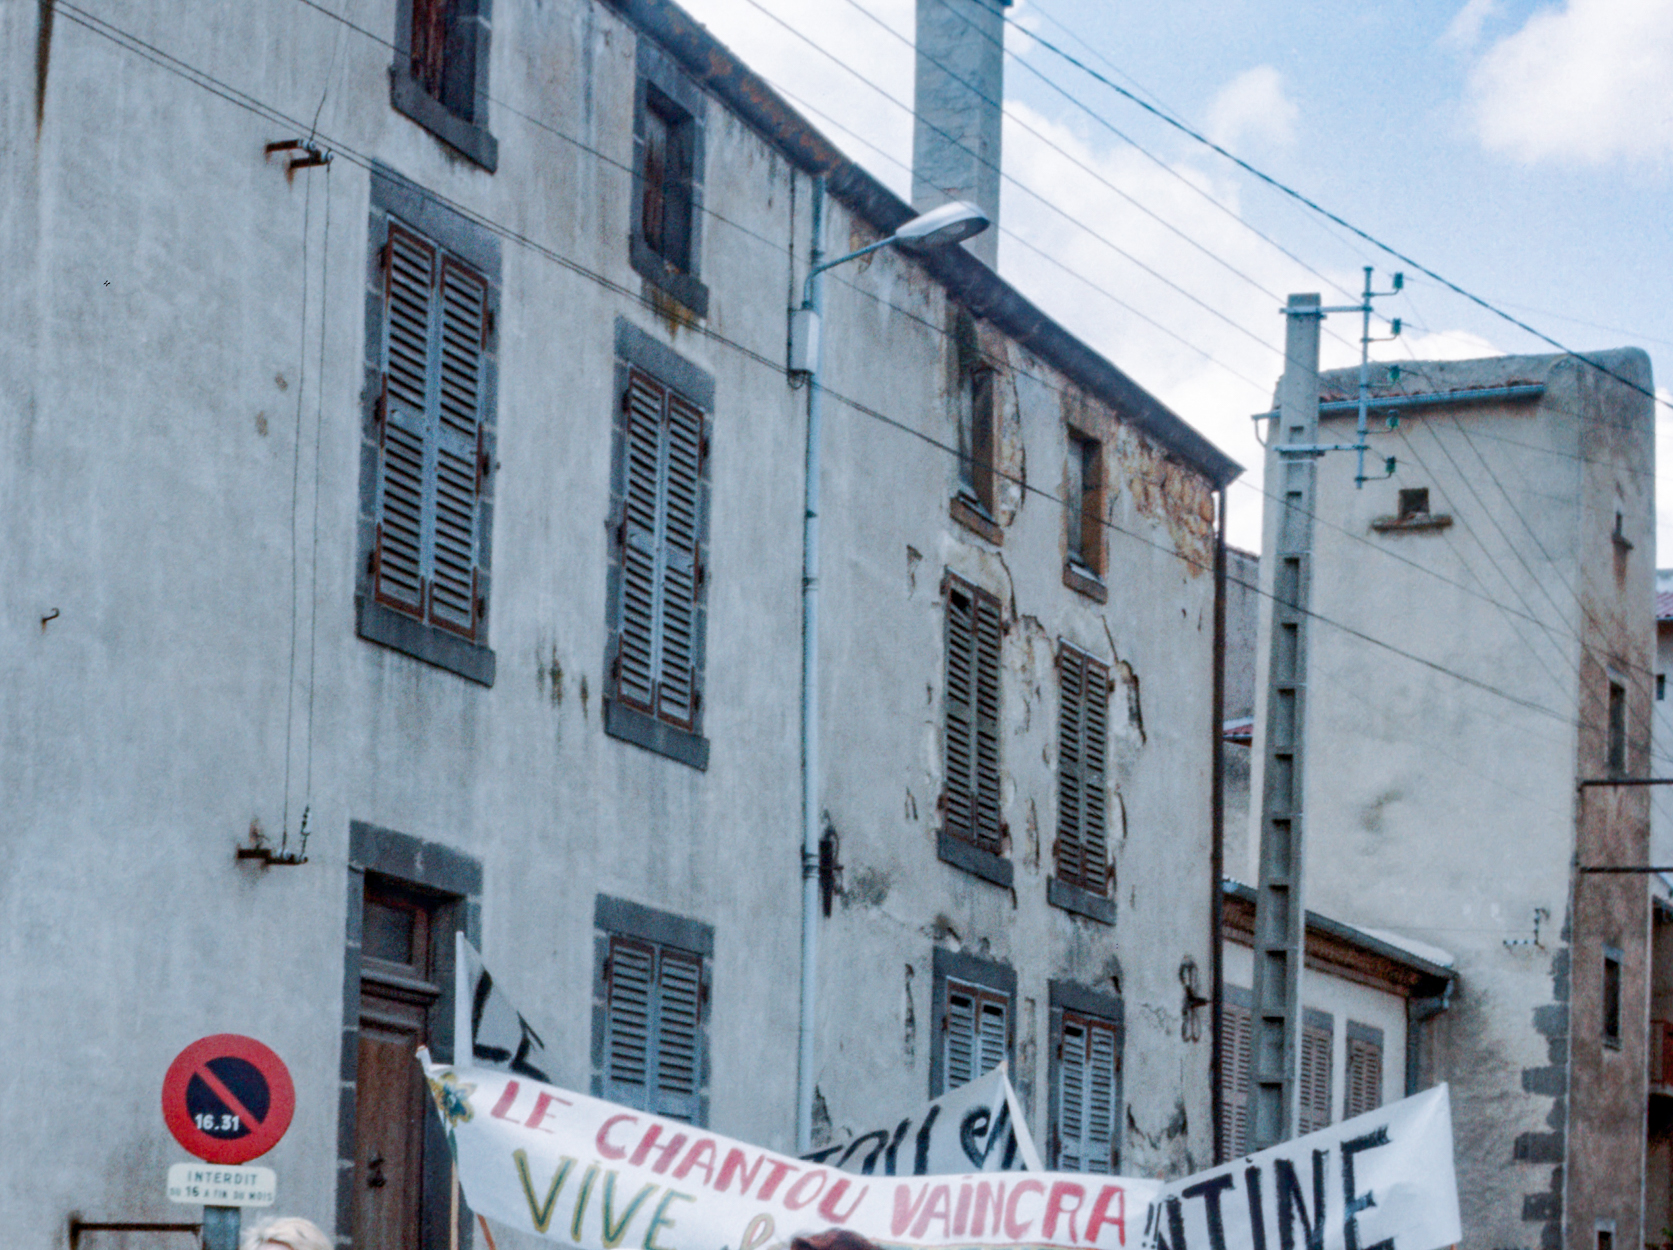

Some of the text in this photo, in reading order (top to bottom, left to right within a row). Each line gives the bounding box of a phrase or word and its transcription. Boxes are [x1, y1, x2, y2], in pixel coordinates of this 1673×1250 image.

[194, 1113, 240, 1131] 16.31
[490, 1080, 573, 1134] LE
[596, 1112, 868, 1224] CHANTOU
[890, 1176, 1126, 1247] VAINCRA
[187, 1170, 258, 1185] INTERDIT
[185, 1185, 200, 1198] 16
[249, 1191, 273, 1202] MOIS
